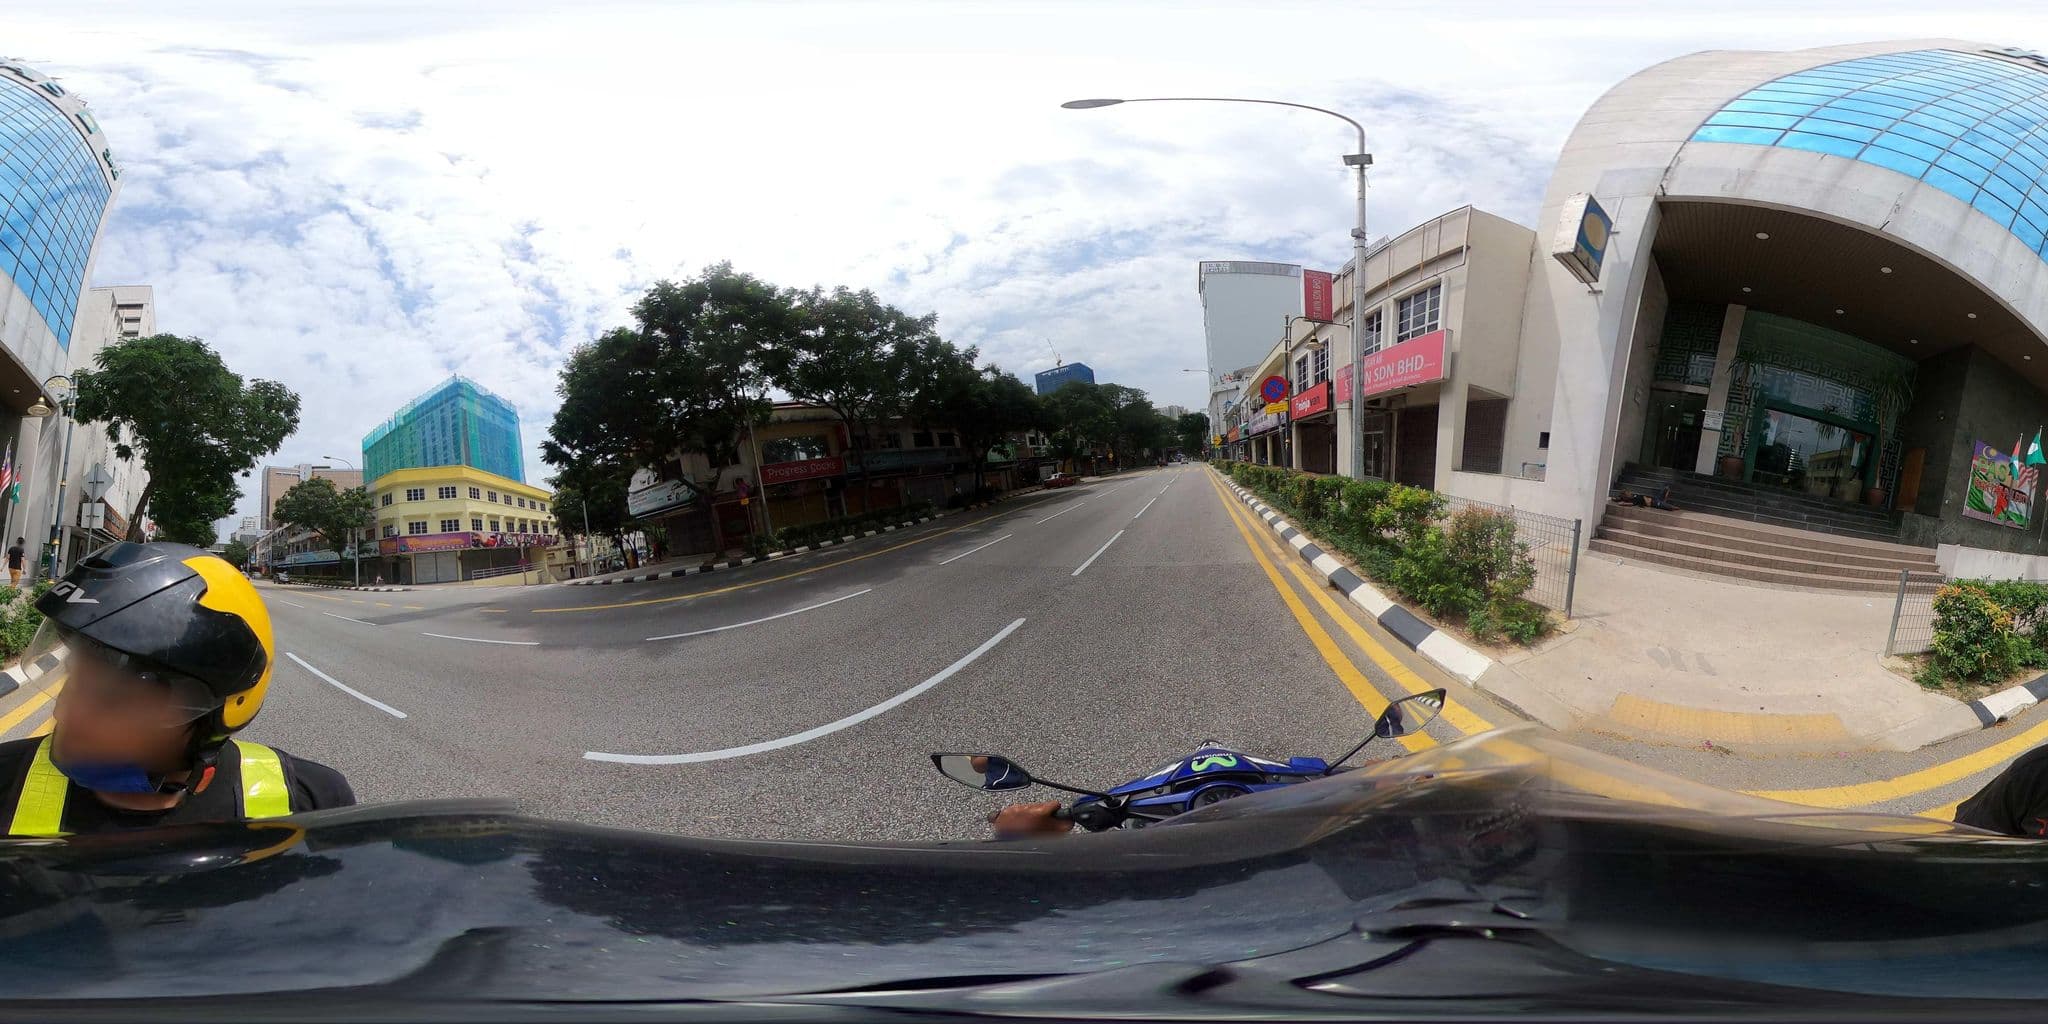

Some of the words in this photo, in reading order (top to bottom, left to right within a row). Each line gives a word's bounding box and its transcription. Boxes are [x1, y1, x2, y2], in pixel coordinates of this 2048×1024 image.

[1374, 363, 1394, 382] SDN
[1397, 354, 1424, 375] BHD
[767, 465, 808, 479] Progress
[1977, 455, 2007, 482] PAS
